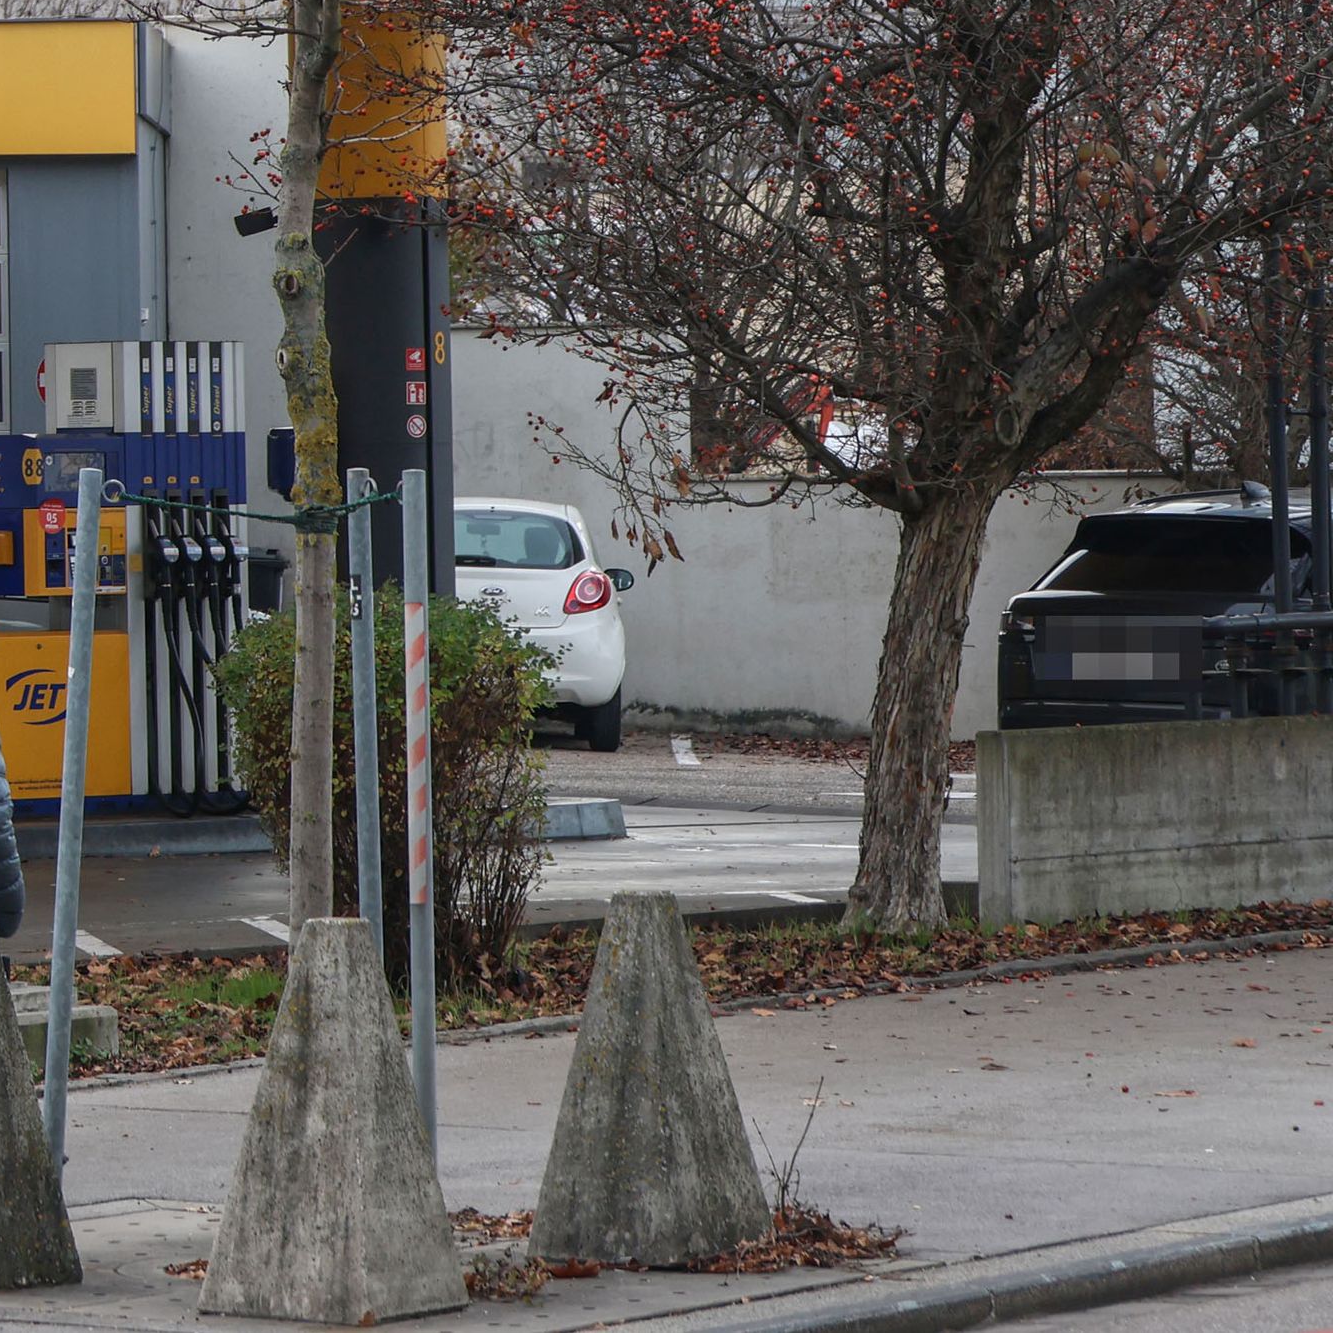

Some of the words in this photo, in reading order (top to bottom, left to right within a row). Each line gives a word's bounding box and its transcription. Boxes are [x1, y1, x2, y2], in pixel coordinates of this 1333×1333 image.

[434, 331, 446, 365] 8
[140, 386, 150, 415] Super
[164, 386, 174, 415] Super
[13, 683, 66, 711] JET
